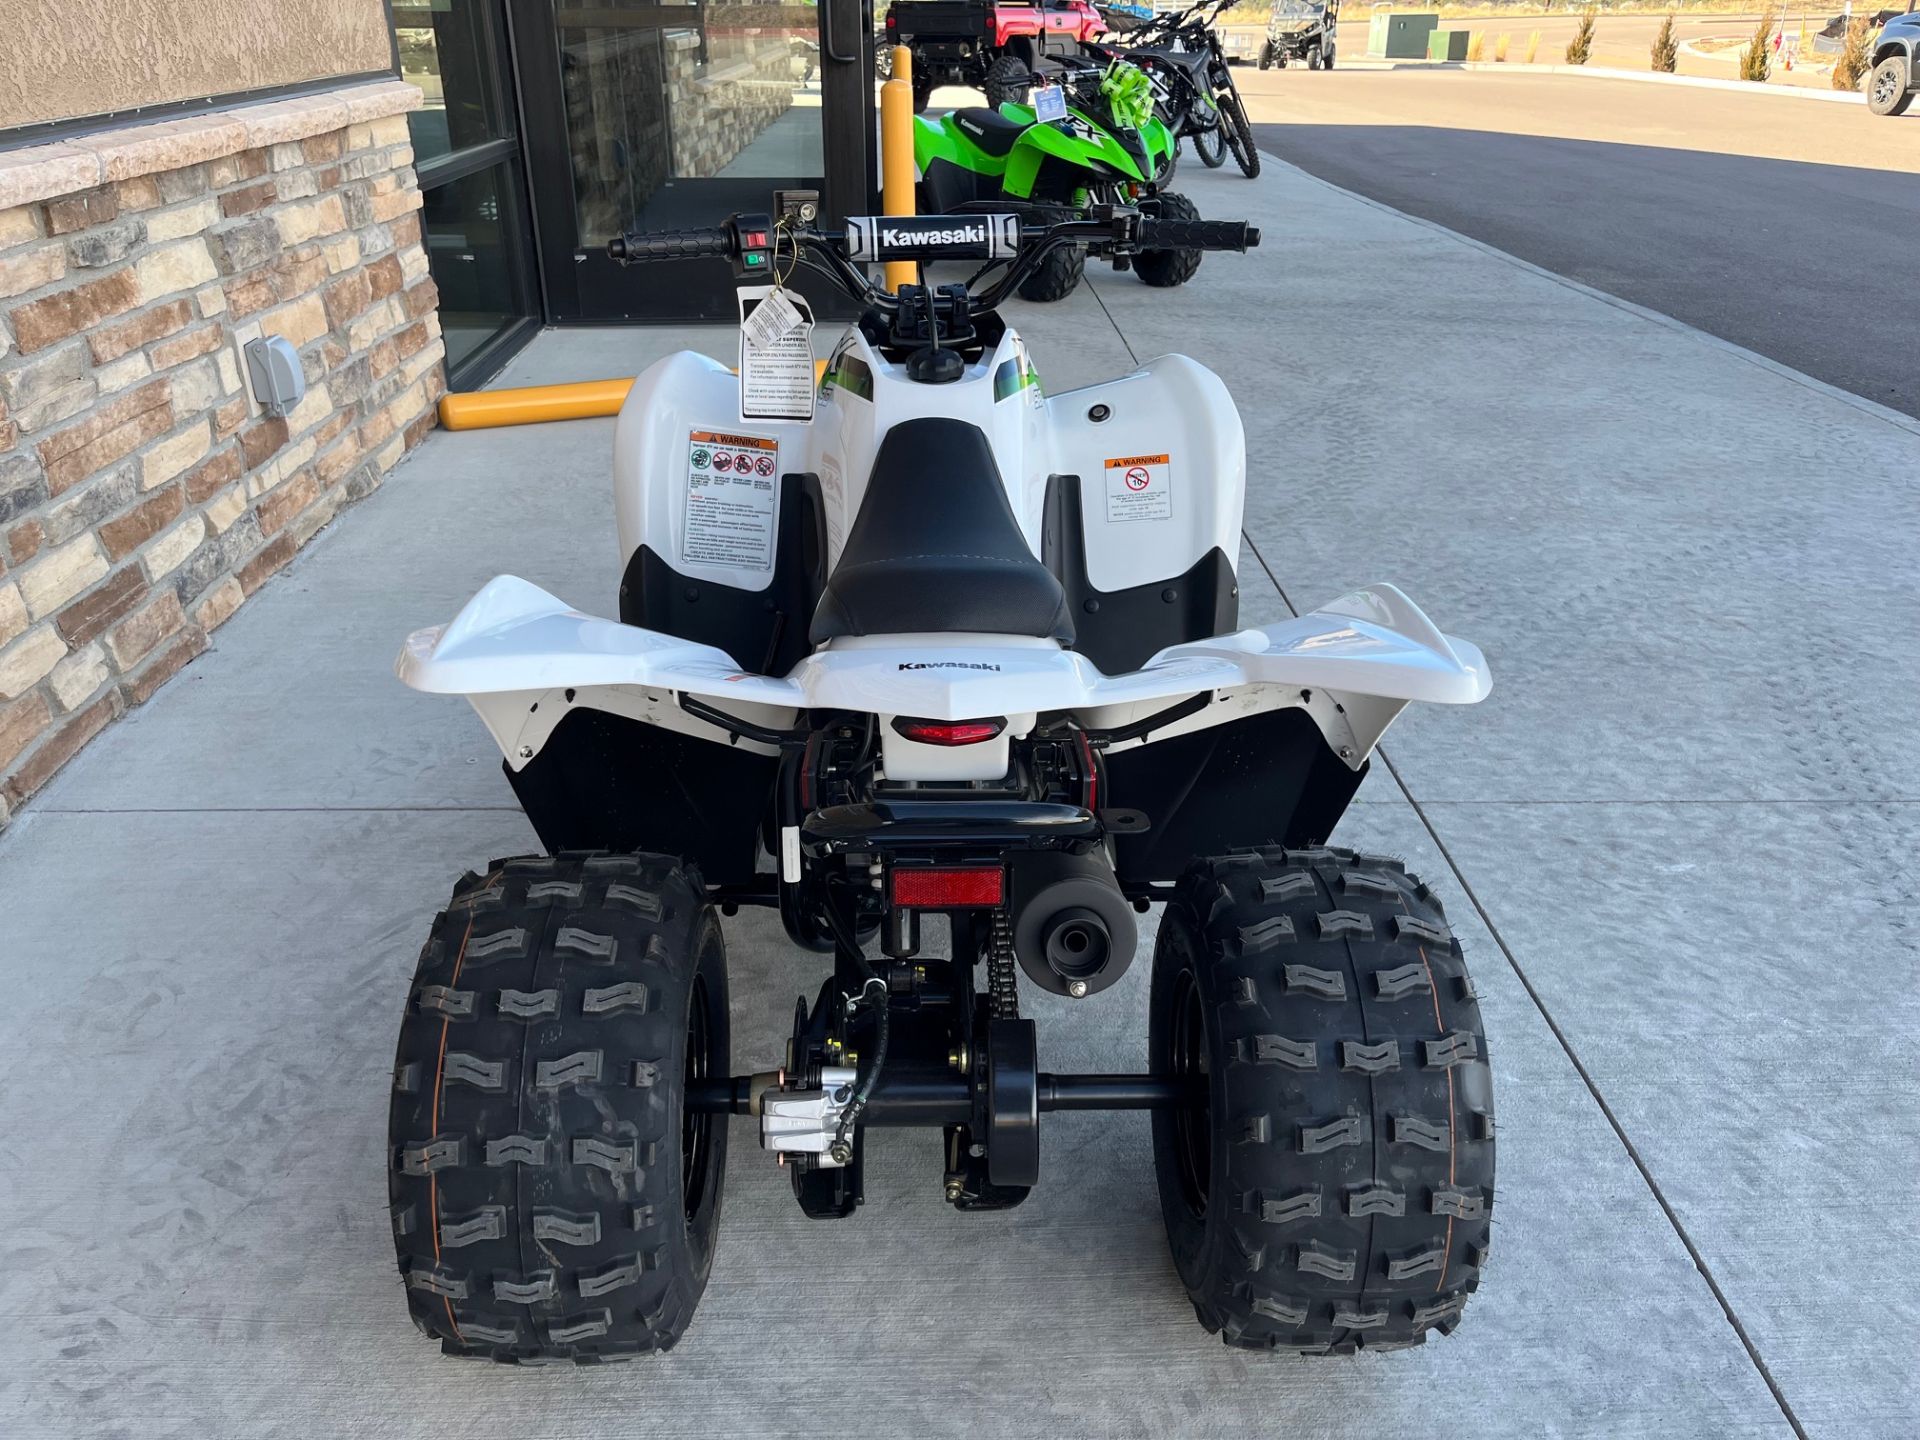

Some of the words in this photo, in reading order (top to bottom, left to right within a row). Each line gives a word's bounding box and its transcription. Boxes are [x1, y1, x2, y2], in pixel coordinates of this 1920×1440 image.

[882, 225, 985, 247] Kawasaki
[720, 435, 760, 448] WARNING
[1123, 456, 1161, 466] WARNING
[1132, 479, 1142, 487] 10
[898, 662, 1001, 672] Kawasaki
